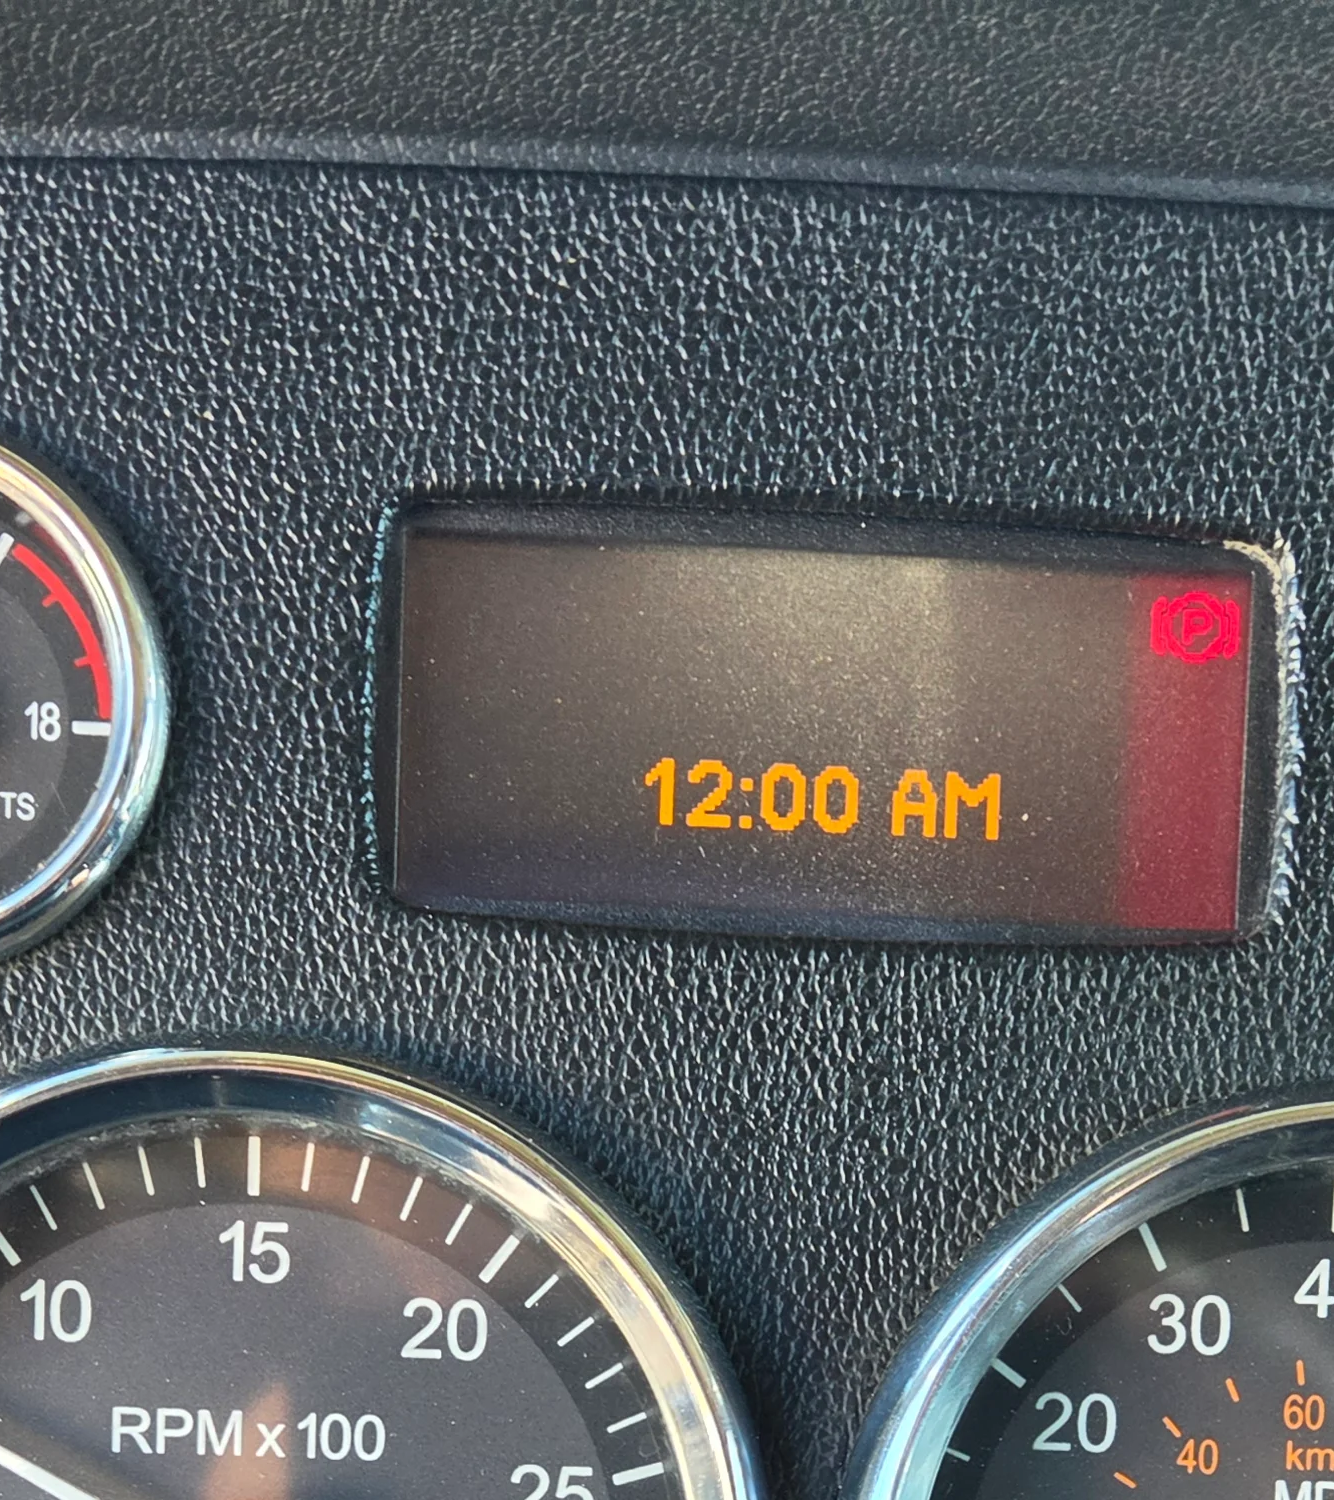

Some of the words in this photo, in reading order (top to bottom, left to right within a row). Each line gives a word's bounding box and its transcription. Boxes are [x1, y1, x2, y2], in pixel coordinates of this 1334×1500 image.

[24, 701, 62, 741] 18
[645, 756, 861, 834] 12:00
[890, 769, 1002, 840] AM
[219, 1221, 291, 1283] 15
[19, 1279, 93, 1342] 10
[400, 1298, 488, 1361] 20
[1147, 1295, 1232, 1355] 30
[110, 1406, 244, 1455] RPM
[254, 1421, 286, 1458] x
[295, 1412, 386, 1461] 100
[1033, 1393, 1117, 1453] 20
[1282, 1394, 1326, 1430] 60
[1176, 1439, 1219, 1475] 40
